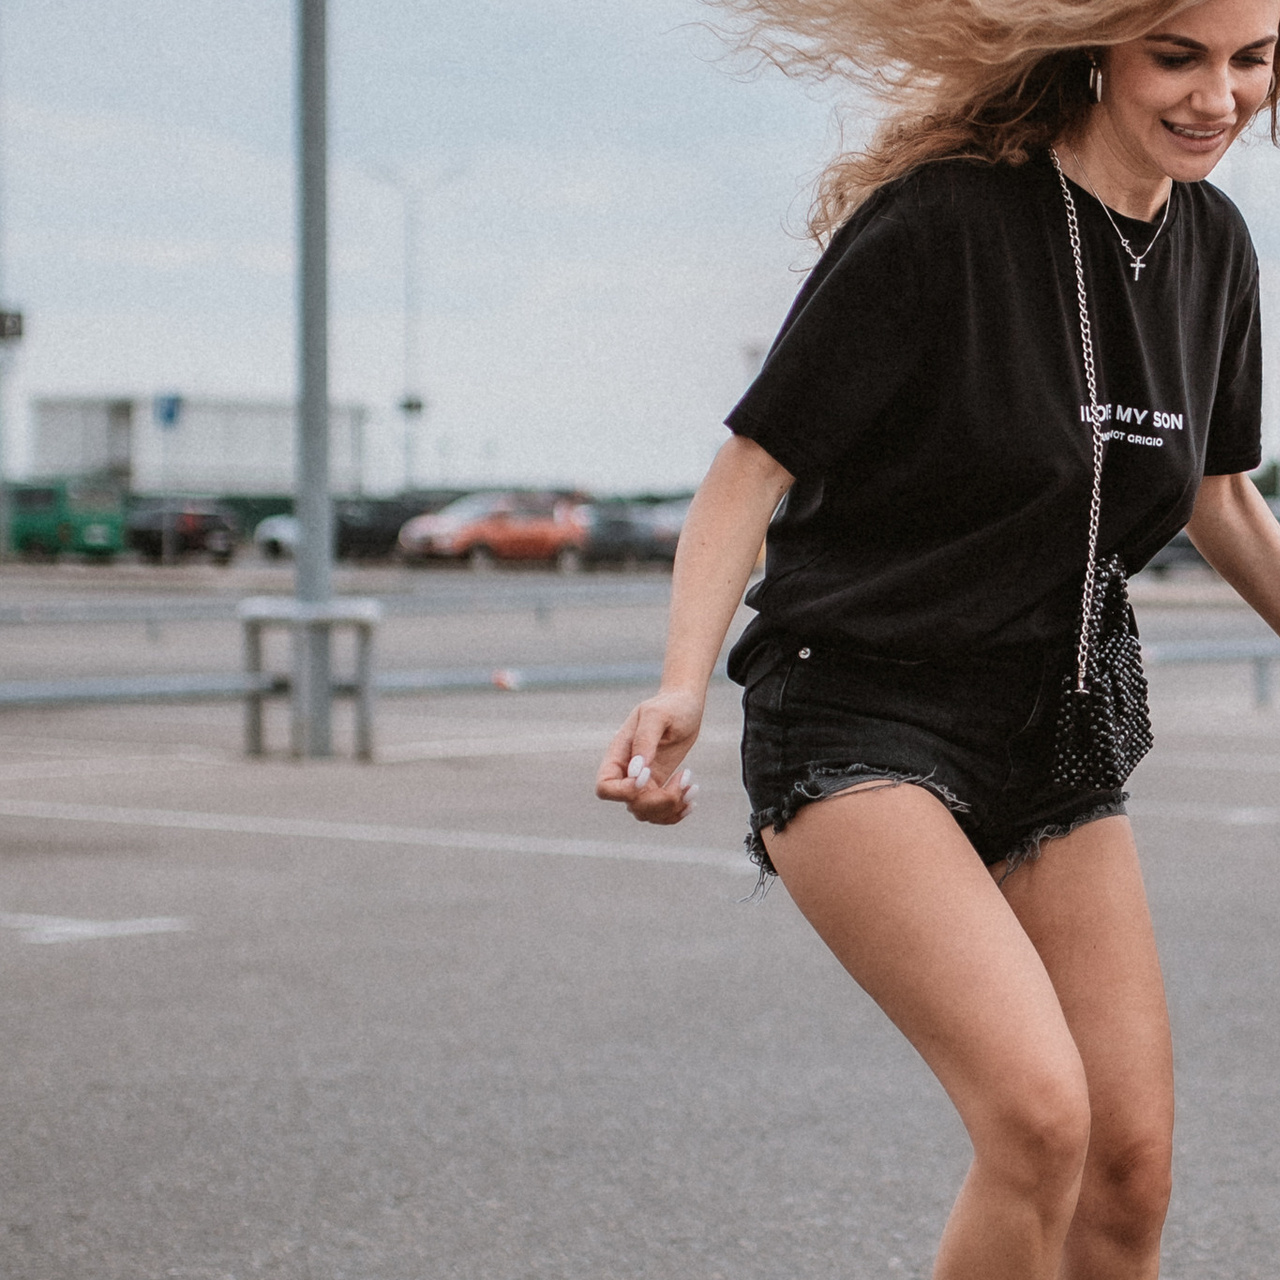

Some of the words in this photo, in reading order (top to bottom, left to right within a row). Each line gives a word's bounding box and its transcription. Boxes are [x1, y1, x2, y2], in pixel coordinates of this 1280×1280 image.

[1116, 405, 1148, 425] MY
[1153, 411, 1183, 430] SON
[1127, 434, 1163, 447] GRIGIO
